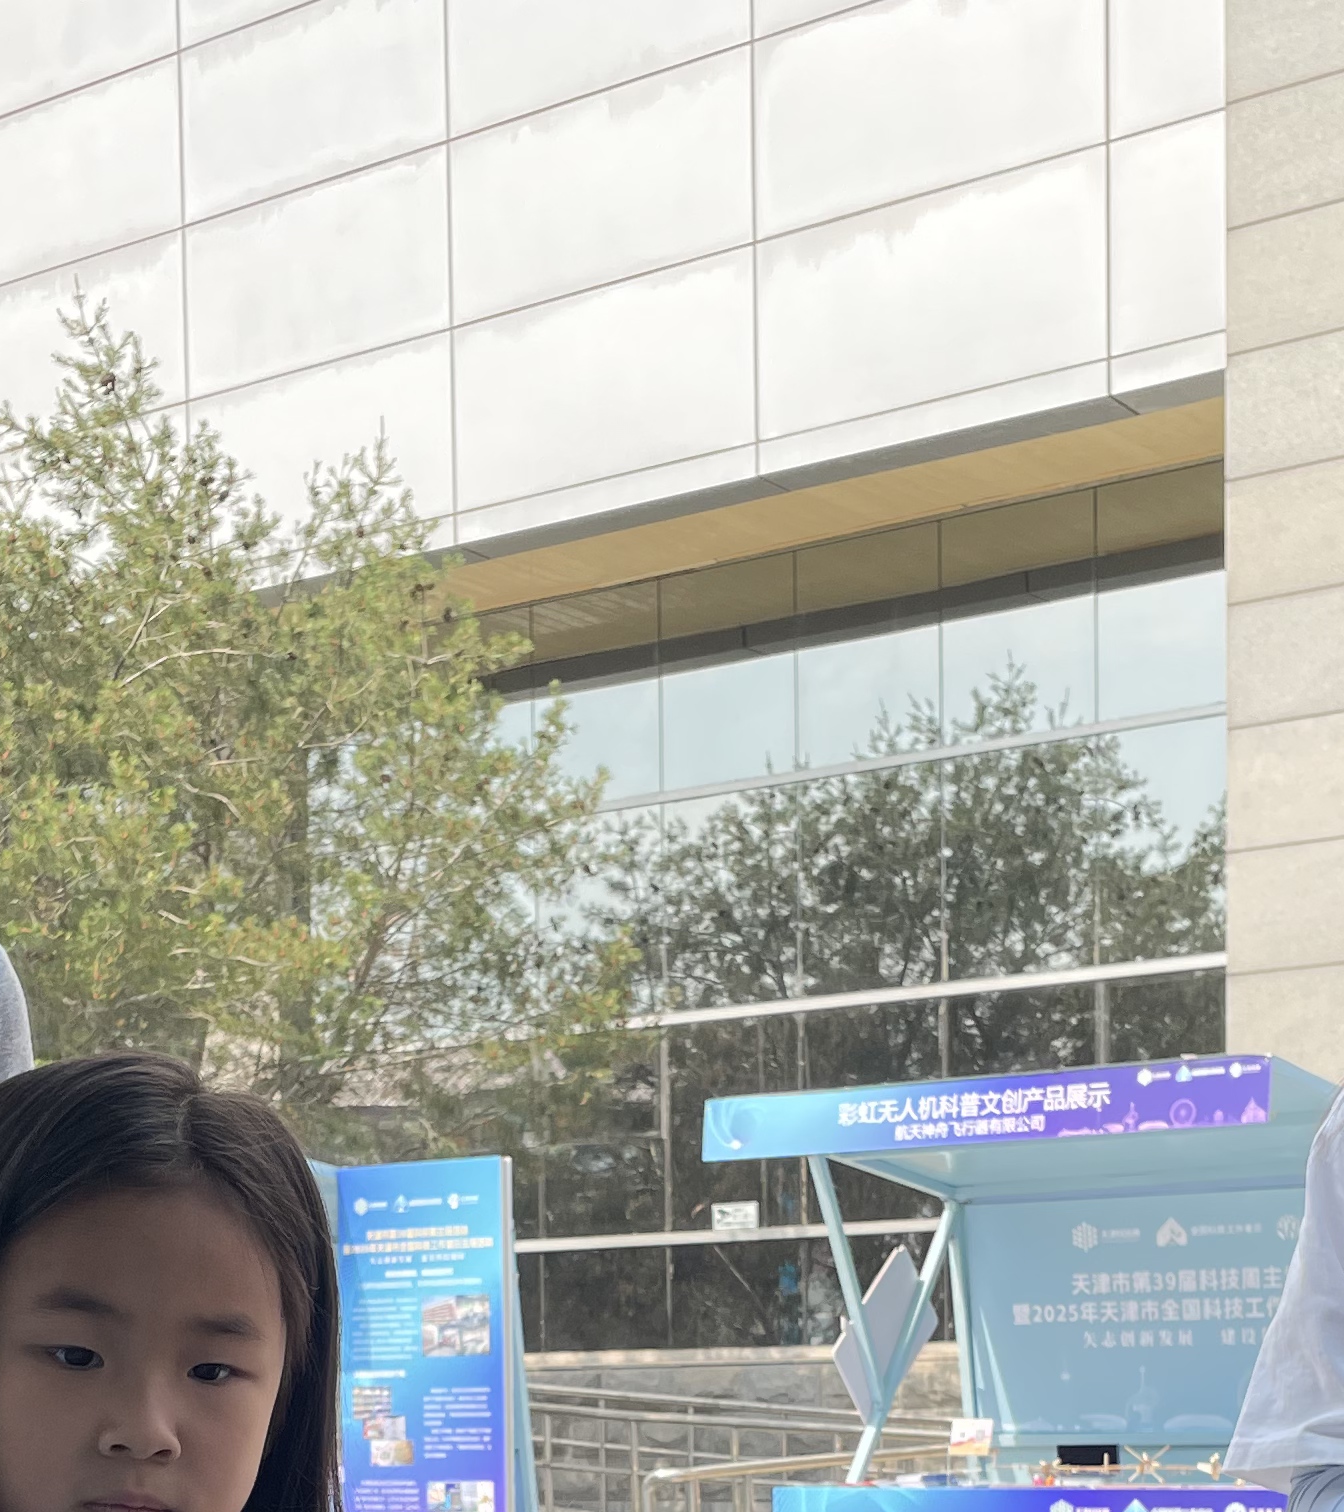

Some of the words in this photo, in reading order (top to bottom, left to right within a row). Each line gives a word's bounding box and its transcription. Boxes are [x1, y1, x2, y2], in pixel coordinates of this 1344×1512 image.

[837, 1081, 1112, 1127] 彩虹无人机科普文创产品展示
[1071, 1265, 1290, 1296] 天津市第39届科技周主
